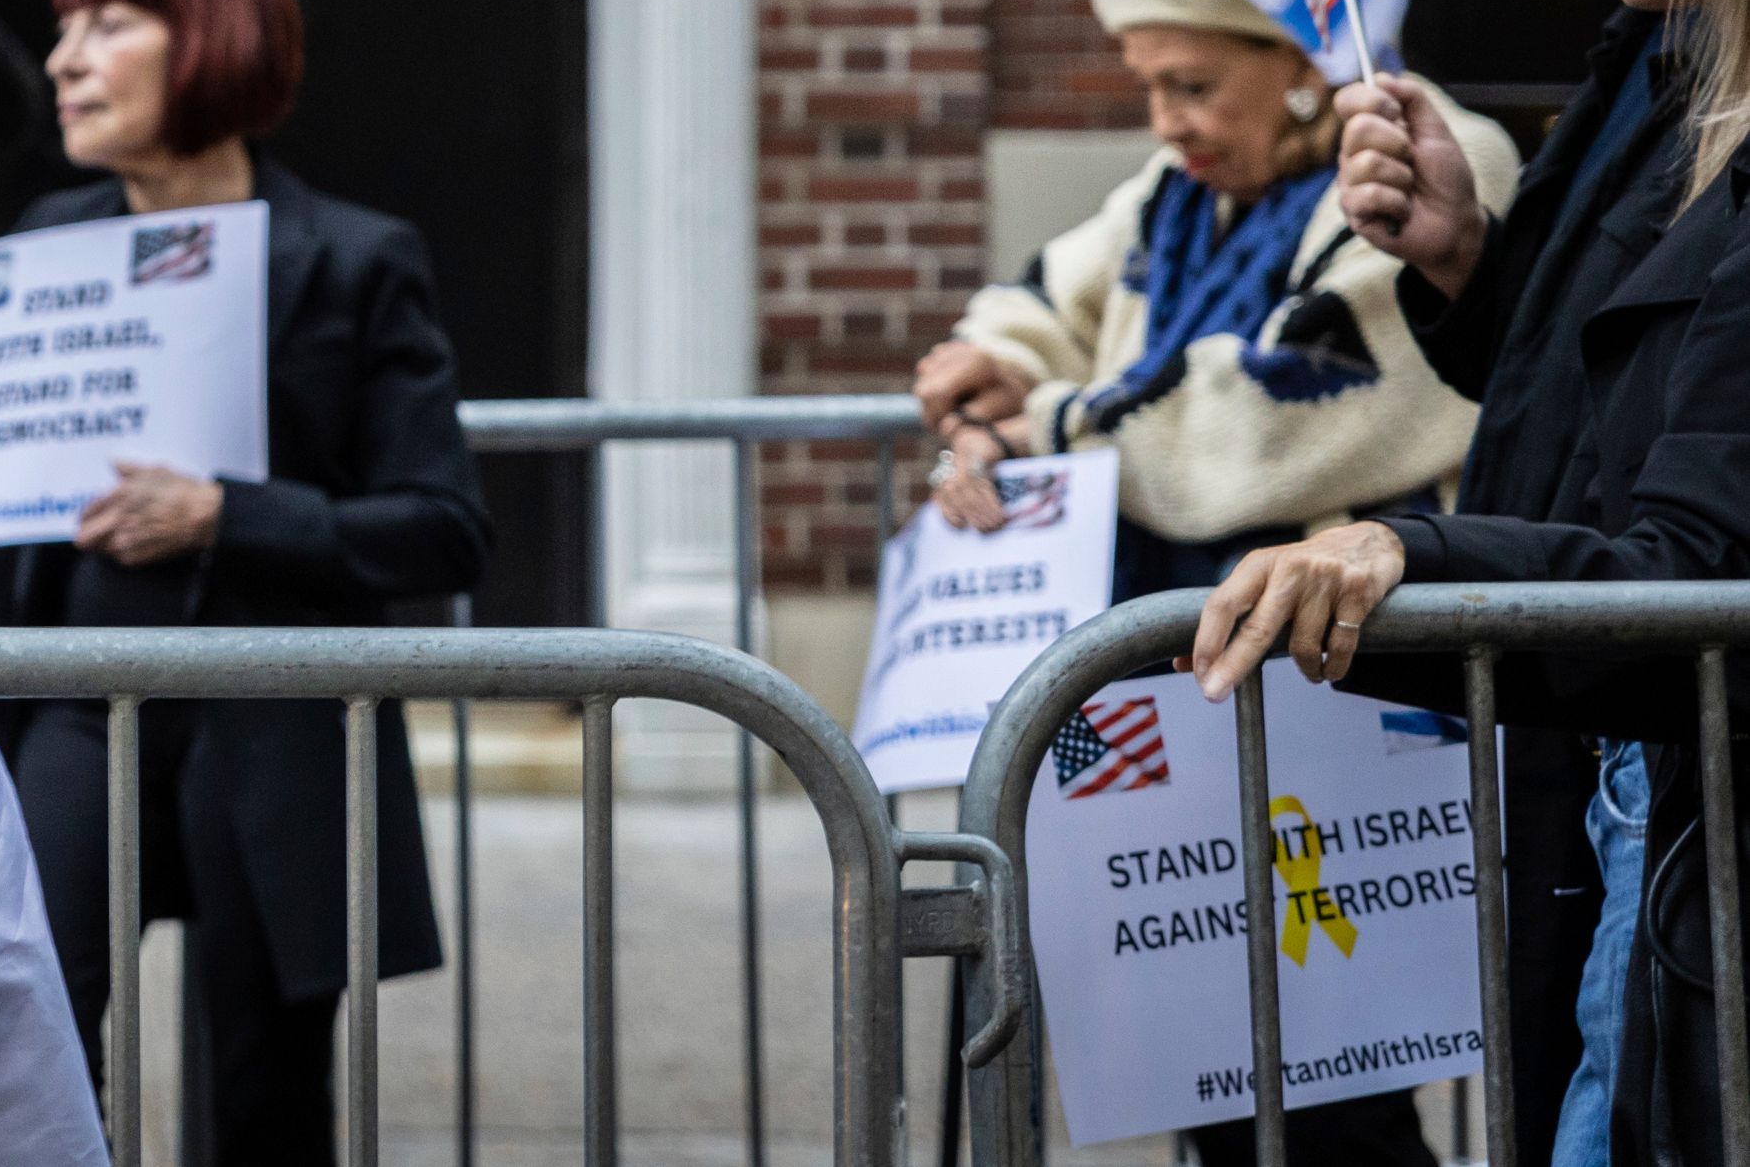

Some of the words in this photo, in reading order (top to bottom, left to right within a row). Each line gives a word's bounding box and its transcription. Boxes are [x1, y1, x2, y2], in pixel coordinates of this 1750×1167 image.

[1107, 838, 1236, 889] STAND
[1267, 819, 1344, 864] ITH
[1114, 898, 1275, 956] AGAINS
[1287, 861, 1506, 926] TERRORIS
[1196, 1028, 1483, 1102] #WetandWithIsra
